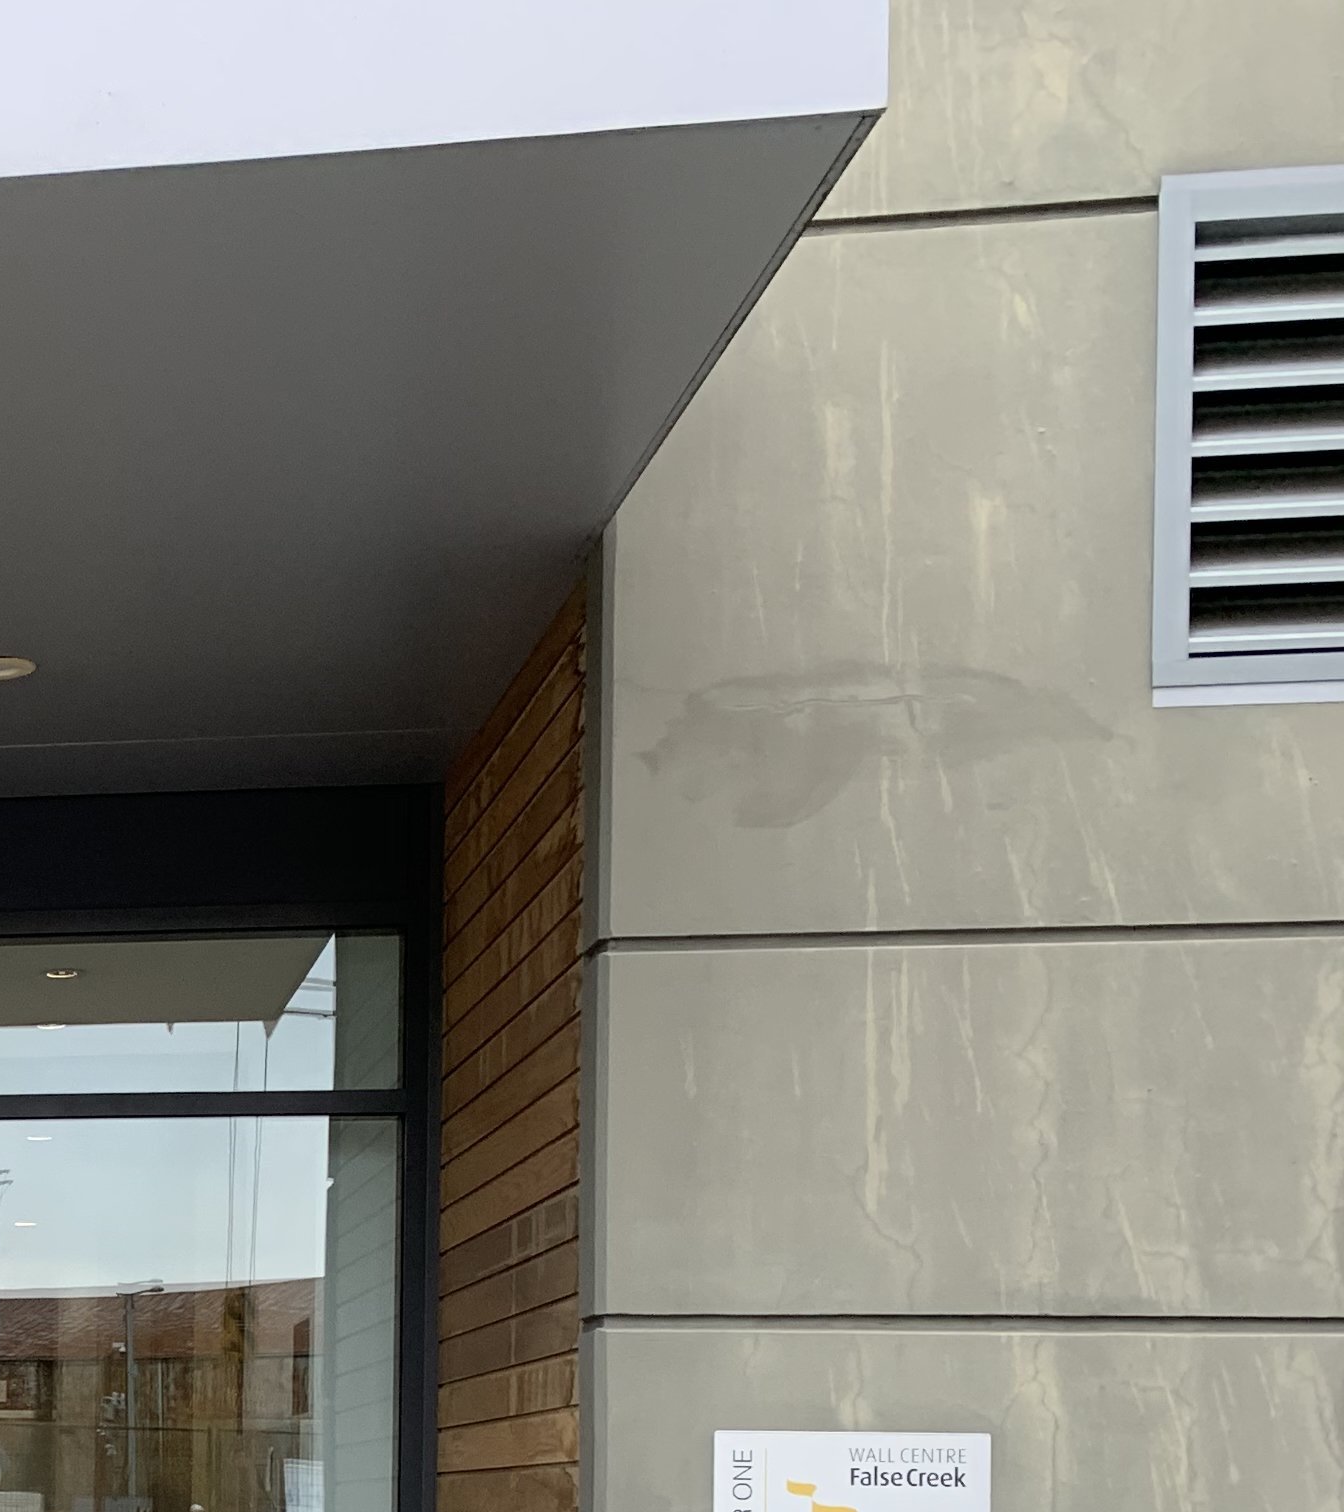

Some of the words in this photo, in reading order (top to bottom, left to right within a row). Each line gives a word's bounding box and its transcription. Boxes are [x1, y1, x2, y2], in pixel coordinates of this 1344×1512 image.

[848, 1447, 895, 1463] WALL
[900, 1447, 967, 1464] CENTRE
[732, 1449, 753, 1501] ONE
